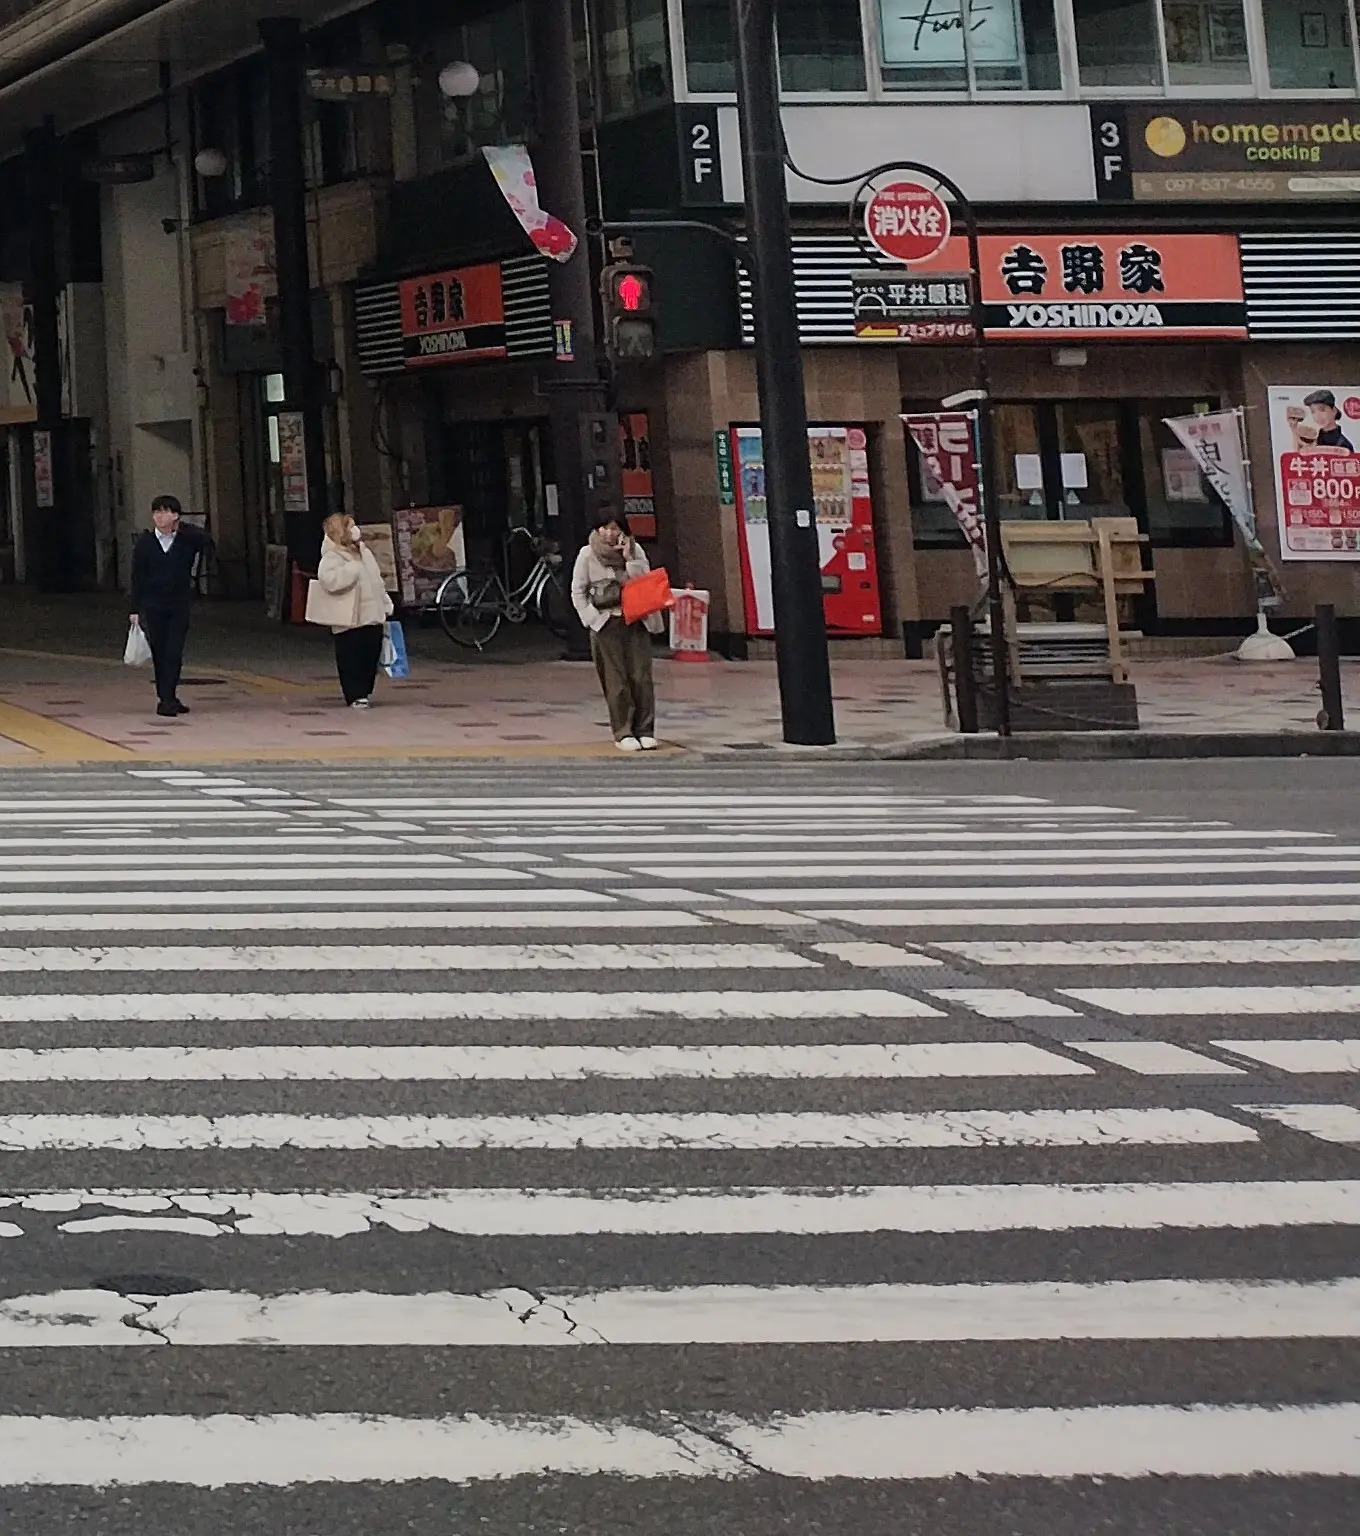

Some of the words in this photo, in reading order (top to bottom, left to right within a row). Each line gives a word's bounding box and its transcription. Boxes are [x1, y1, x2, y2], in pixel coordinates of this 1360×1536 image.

[1246, 145, 1321, 162] cooking
[872, 205, 943, 237] 消火栓
[888, 284, 968, 305] 平井眼科
[1006, 304, 1164, 328] YOSHINOYA
[1289, 456, 1330, 478] 牛丼
